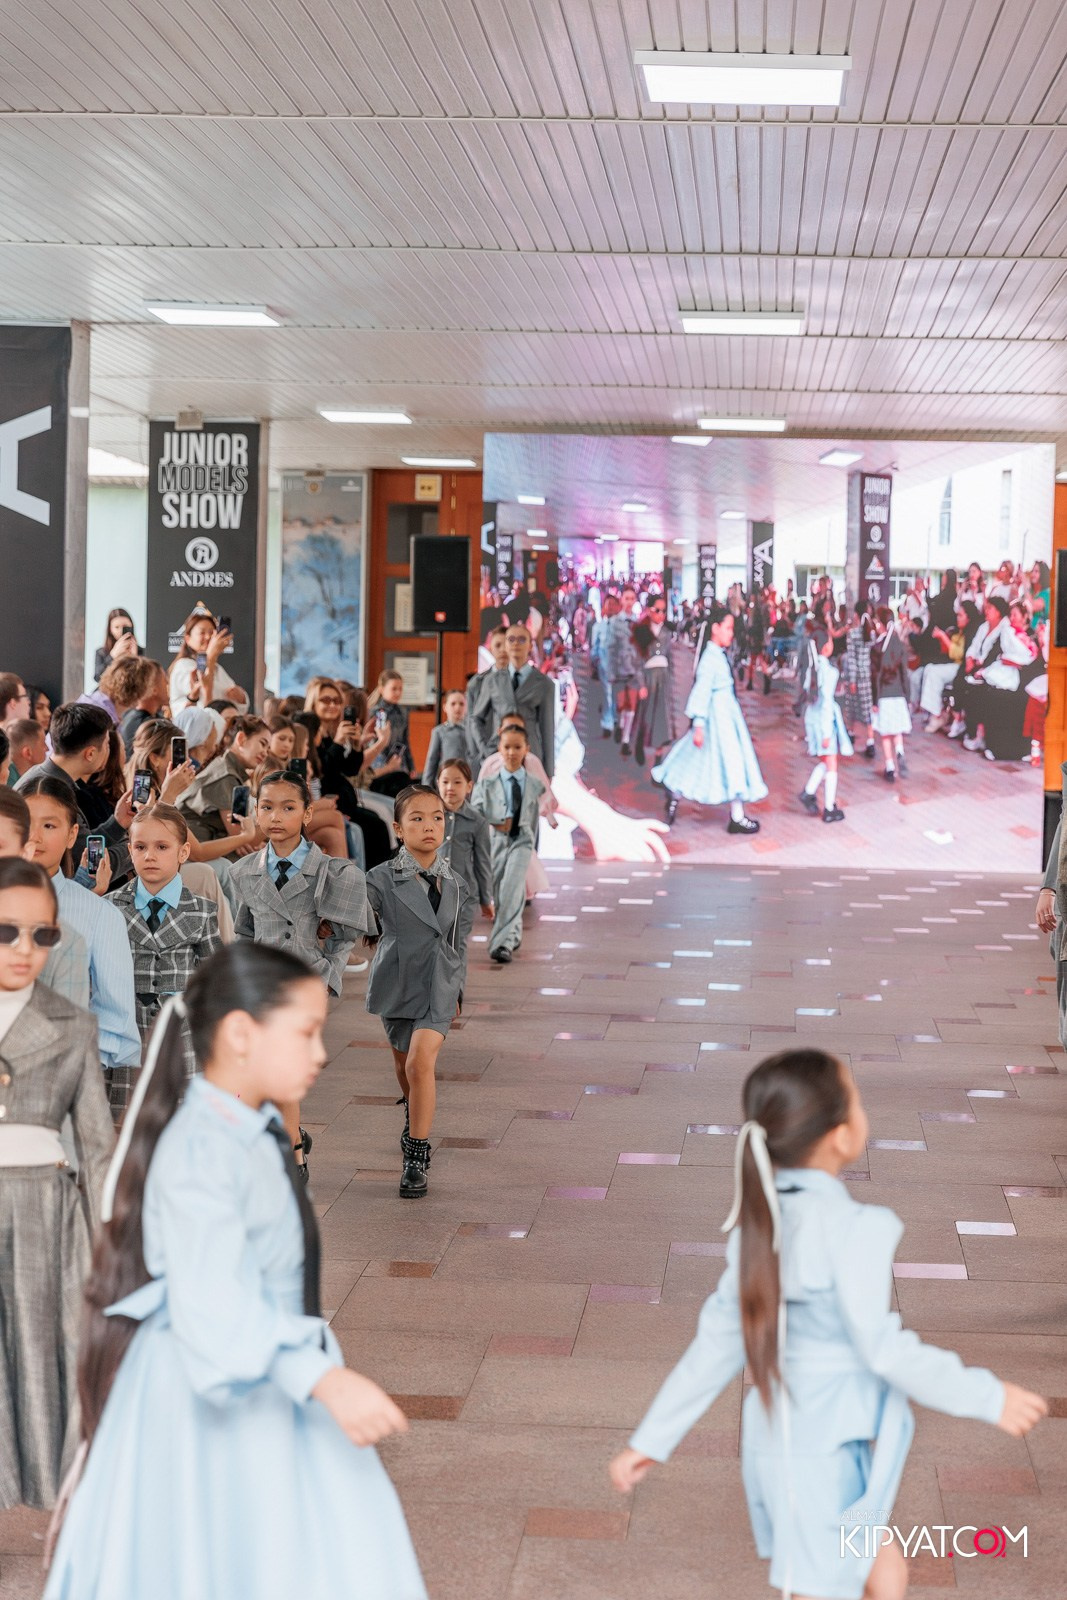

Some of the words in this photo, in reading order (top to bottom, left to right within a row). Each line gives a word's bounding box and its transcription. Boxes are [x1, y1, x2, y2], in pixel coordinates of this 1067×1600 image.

[159, 432, 249, 466] JUNIOR
[157, 463, 249, 495] MODELS
[161, 491, 244, 529] SHOW
[170, 571, 235, 588] ANDRES
